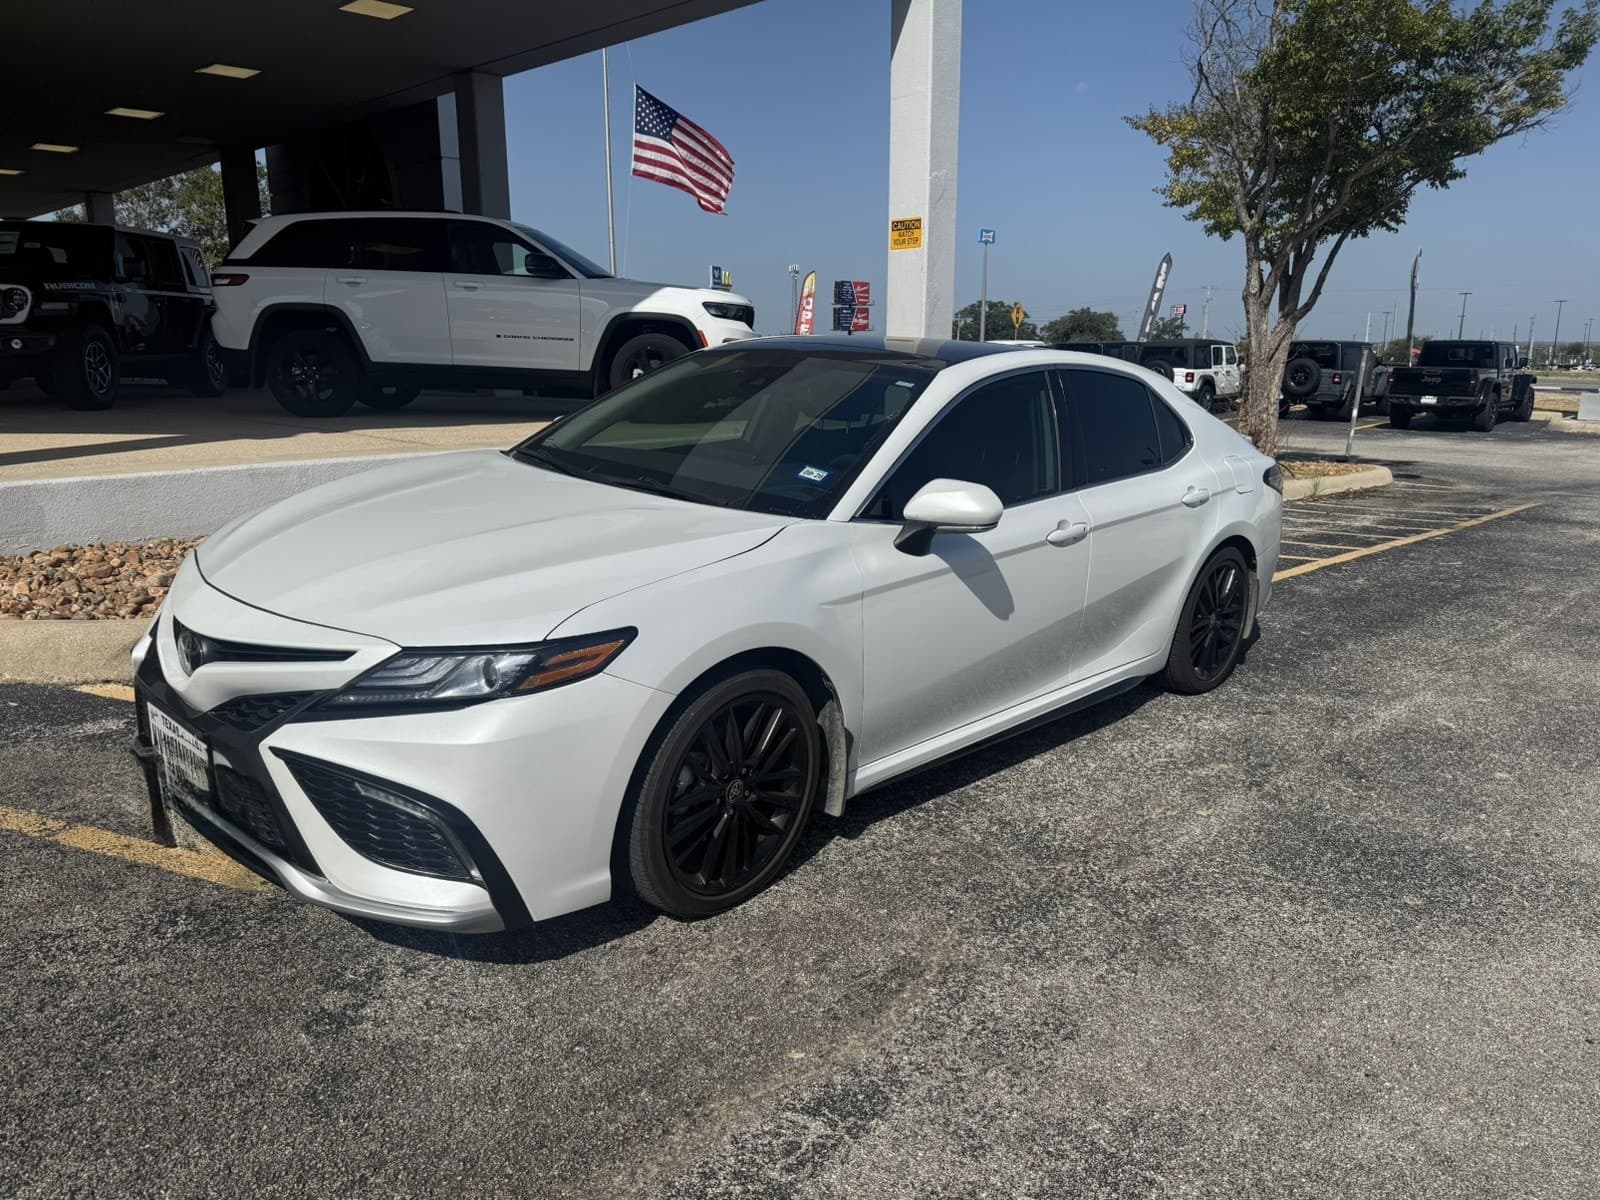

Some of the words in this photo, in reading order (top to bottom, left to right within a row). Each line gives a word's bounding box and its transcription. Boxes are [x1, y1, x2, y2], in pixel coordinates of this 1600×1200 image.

[893, 219, 921, 230] CAUTION
[44, 282, 96, 290] RUBICON
[1421, 376, 1441, 384] Jeep
